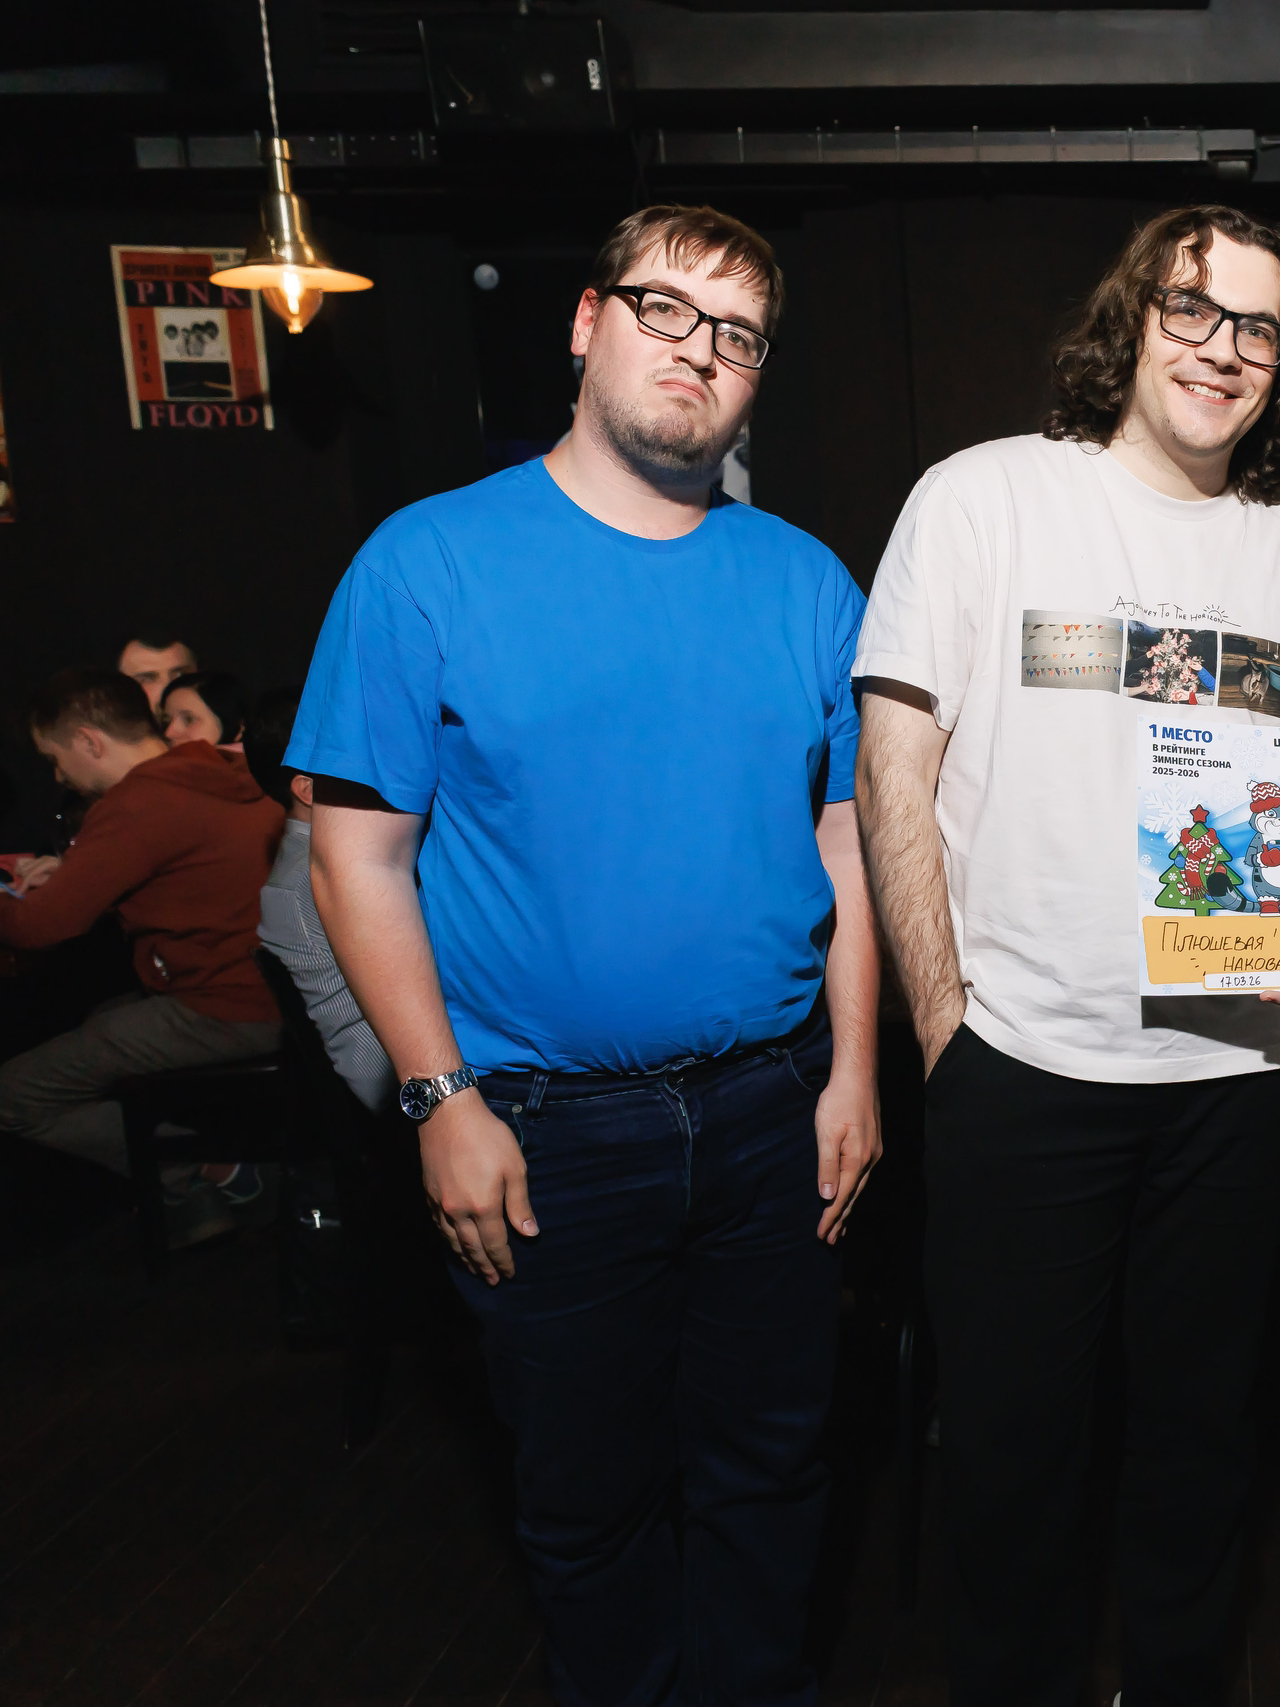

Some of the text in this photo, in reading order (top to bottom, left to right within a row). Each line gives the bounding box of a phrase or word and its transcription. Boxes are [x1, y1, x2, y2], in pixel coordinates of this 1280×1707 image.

[136, 280, 245, 307] PINK
[150, 404, 260, 428] FLOYD
[1149, 724, 1213, 743] 1 МЕСТО
[1152, 743, 1206, 756] В РЕЙТИНГЕ
[1152, 755, 1232, 769] ЗИМНЕГО СЕЗОНА
[1152, 766, 1200, 778] 2025-2026
[1220, 976, 1261, 988] 17.03.26
